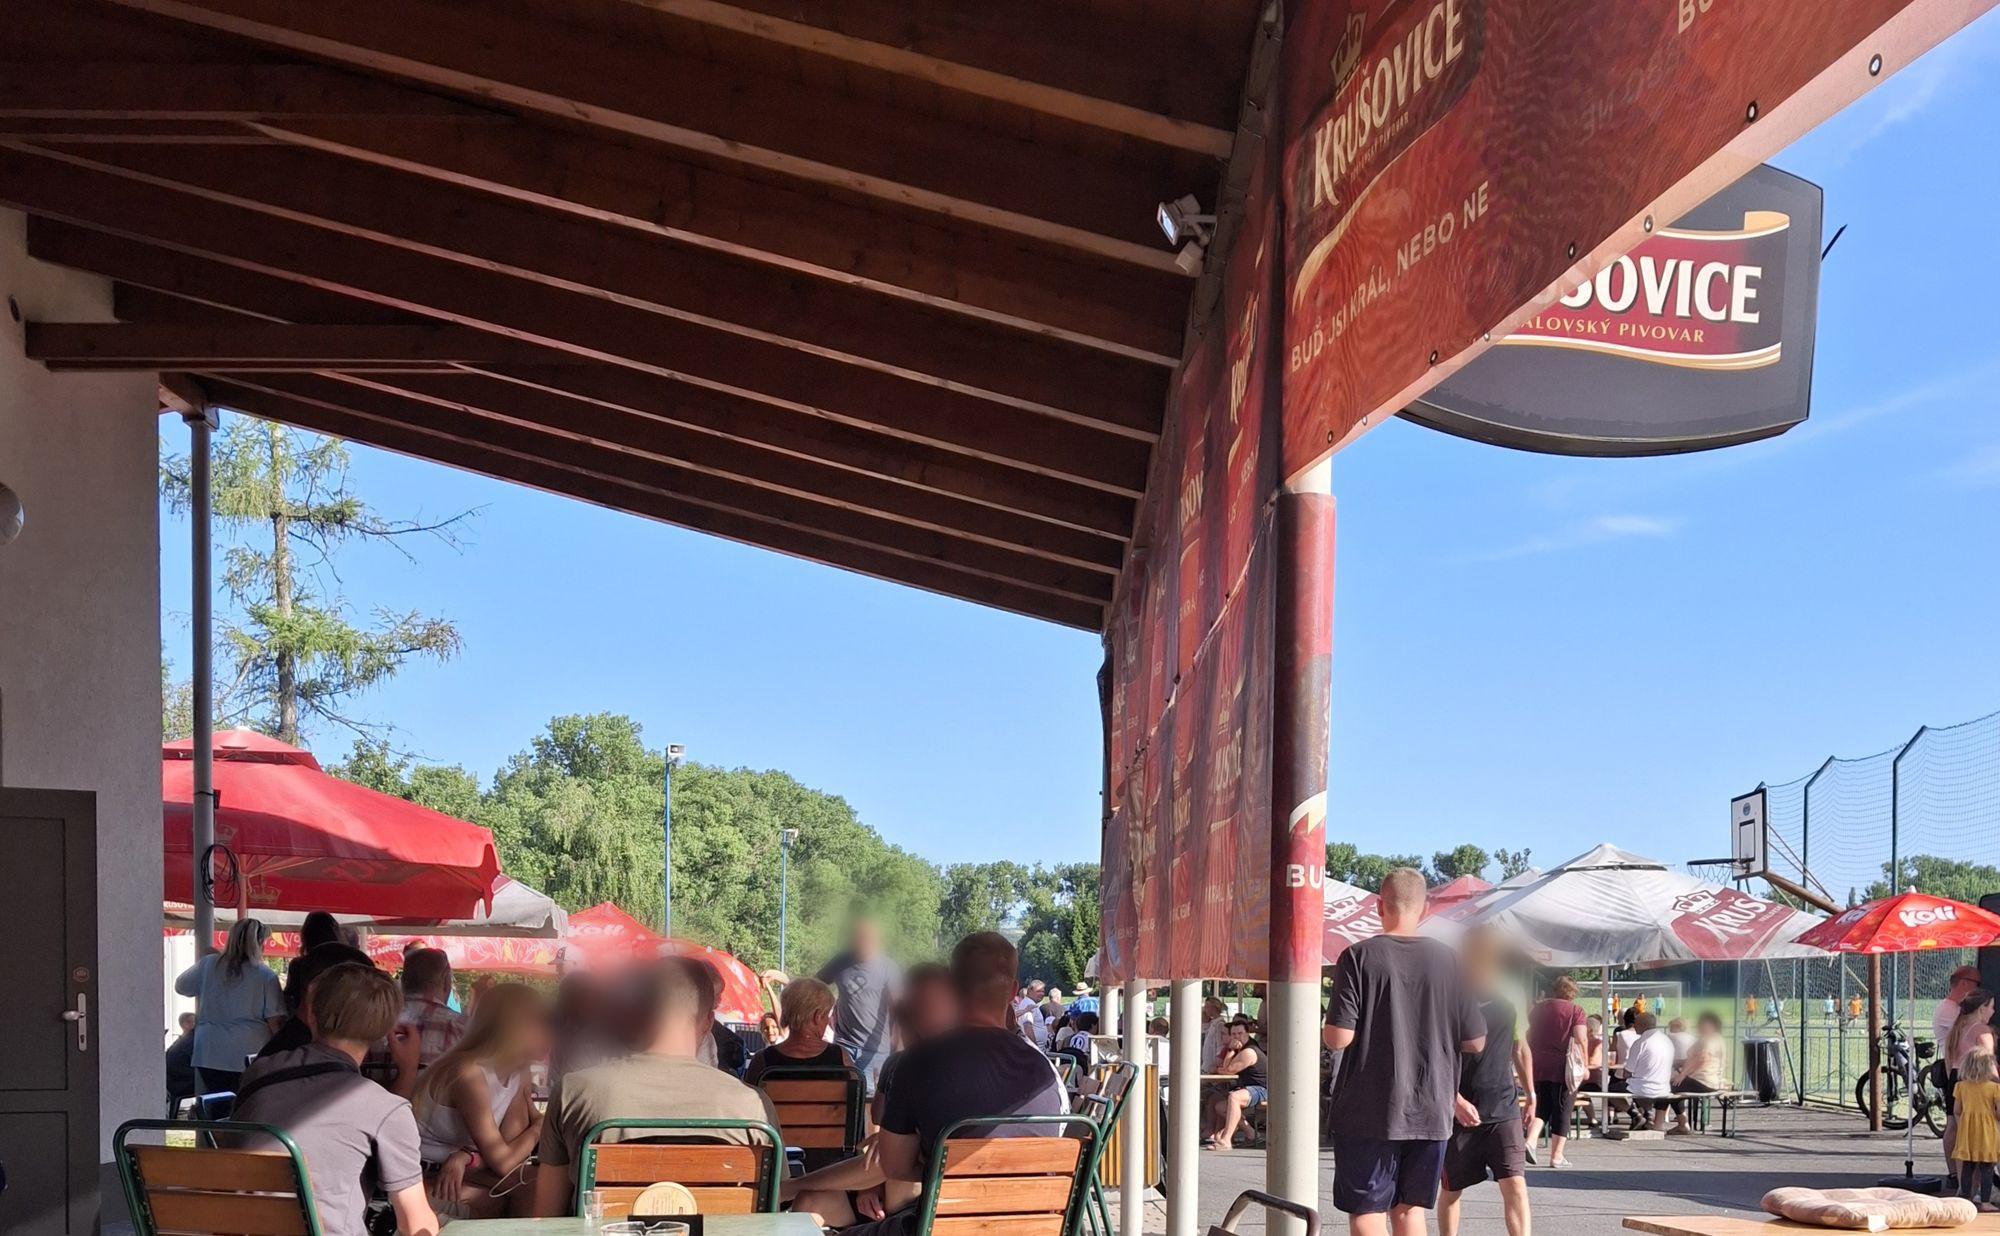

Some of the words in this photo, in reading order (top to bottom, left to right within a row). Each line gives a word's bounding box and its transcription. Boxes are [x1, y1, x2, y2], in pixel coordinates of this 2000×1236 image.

[1313, 0, 1465, 208] KRUŠOVICE
[1291, 316, 1324, 373] BUĎ
[1328, 303, 1348, 345] JSI
[1350, 264, 1392, 323] KRÁL,
[1396, 212, 1456, 277] NEBO
[1463, 180, 1490, 230] NE
[1619, 322, 1705, 344] PIVOVAR
